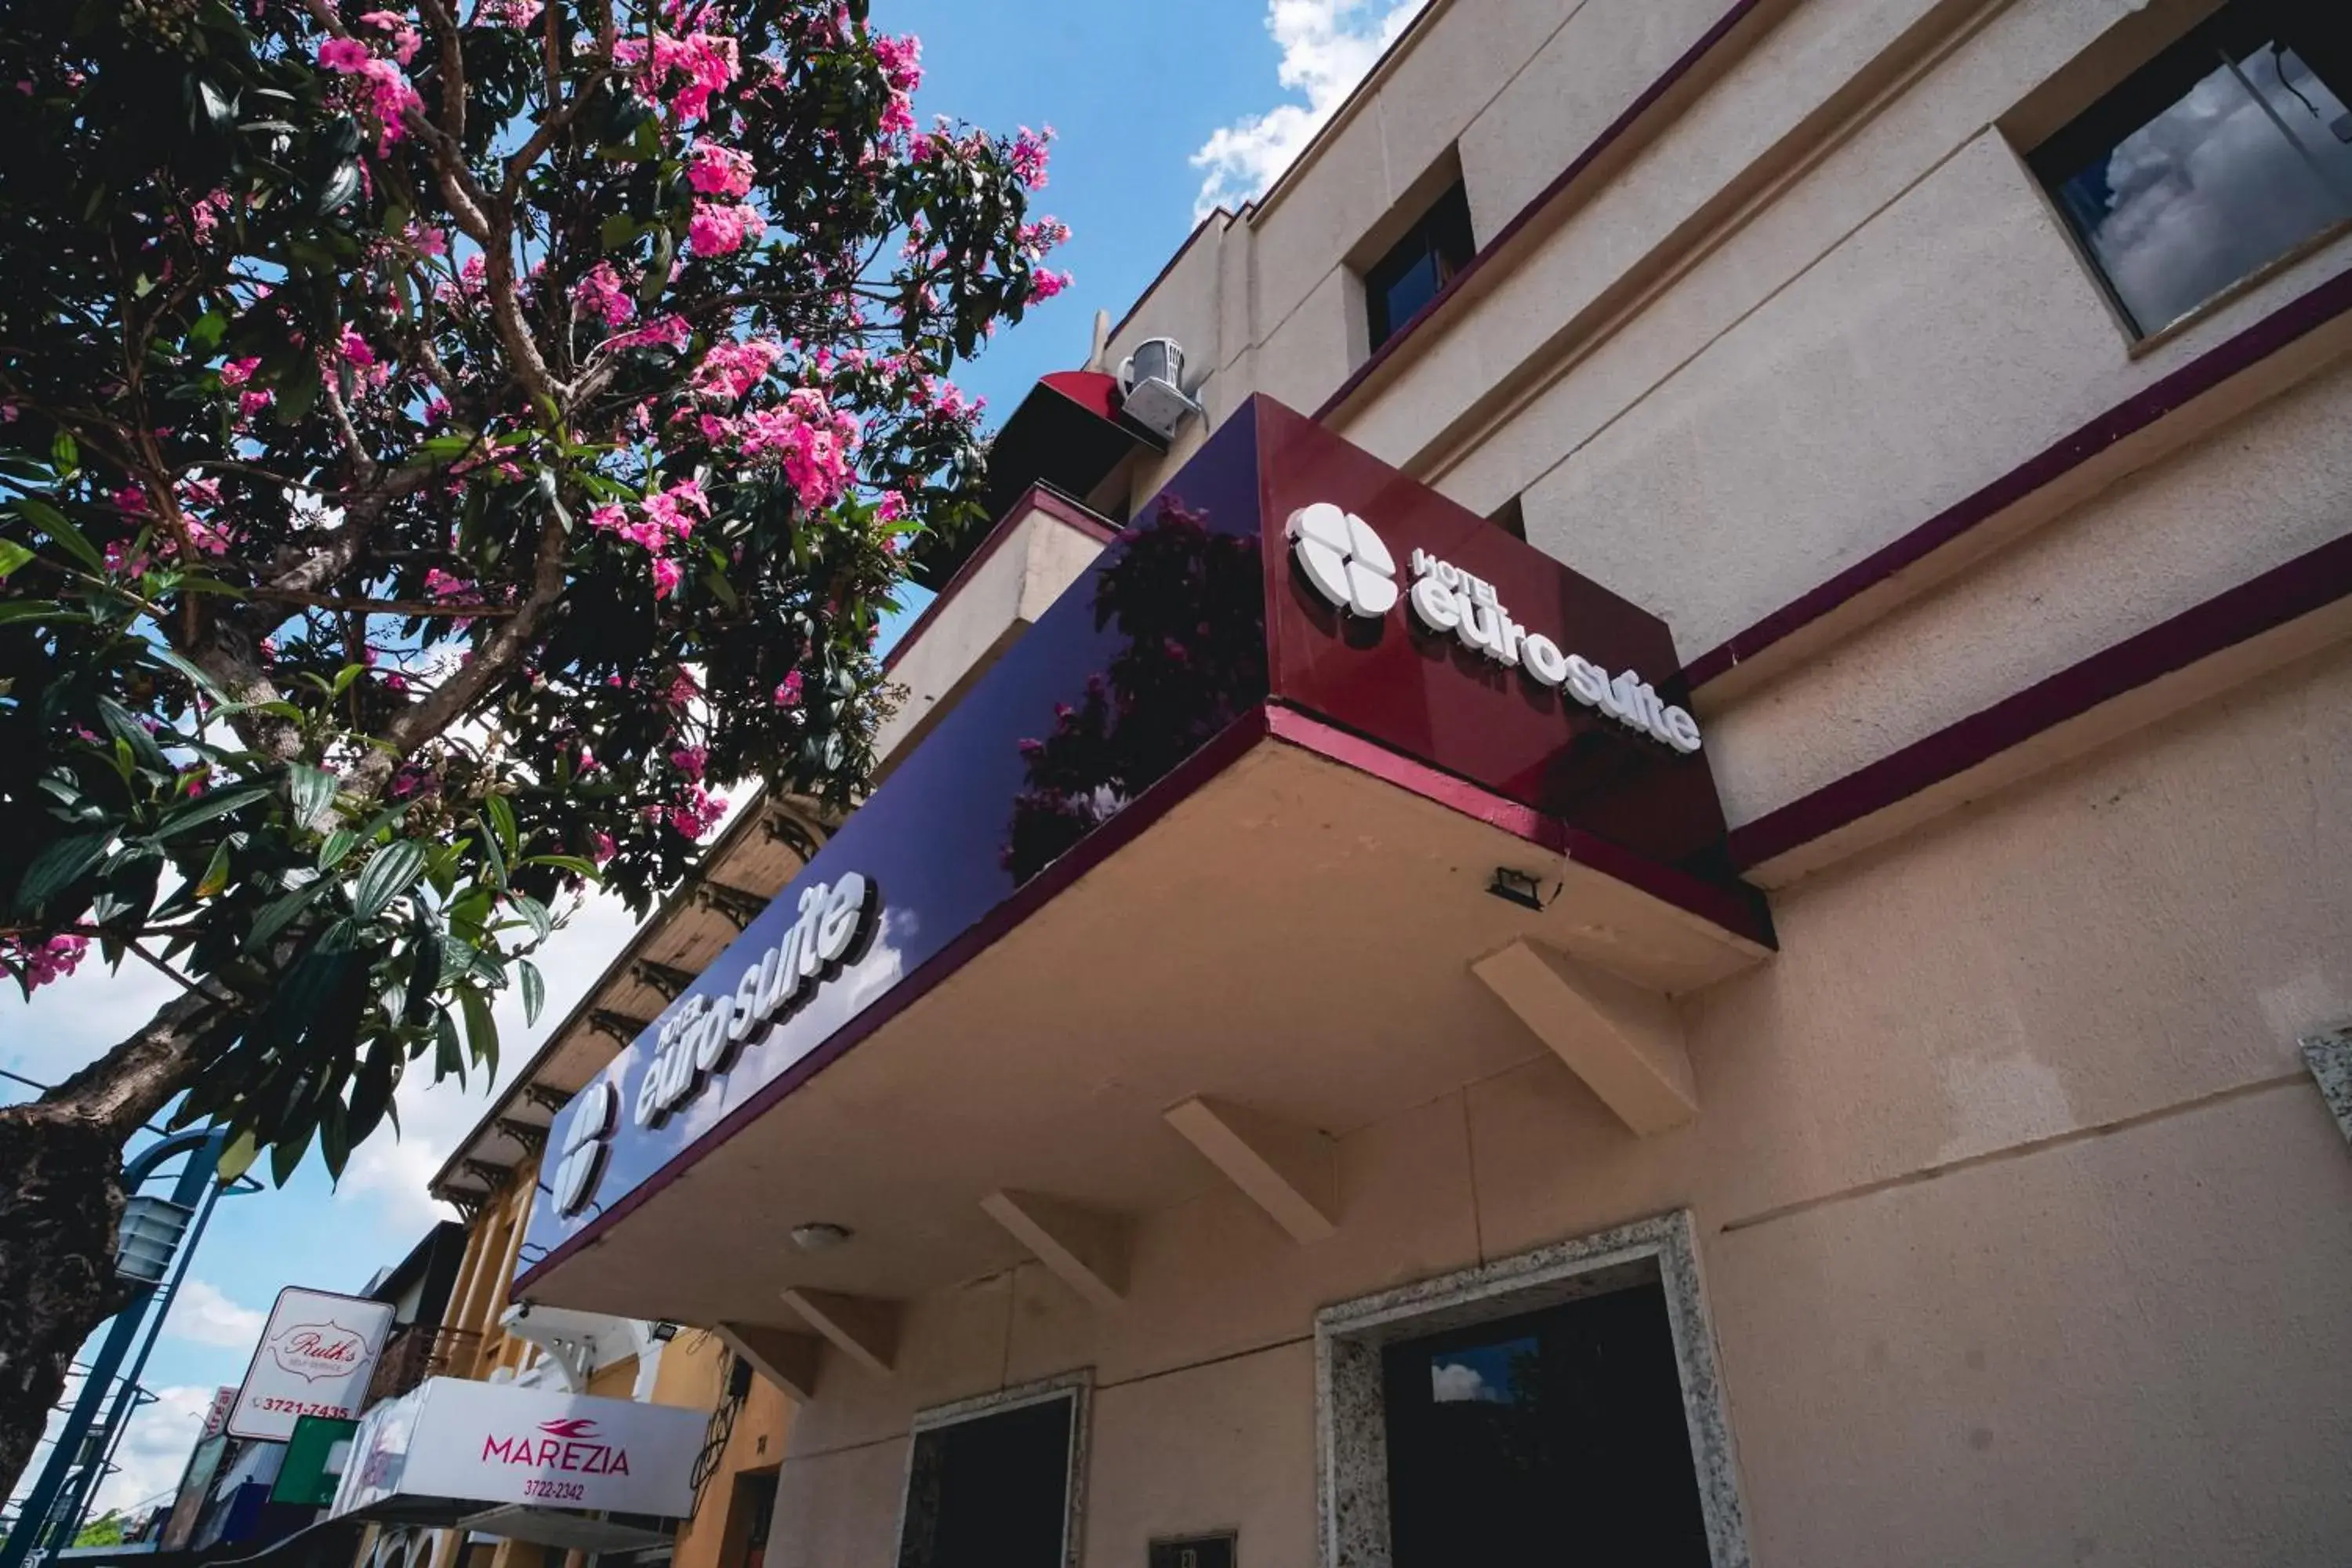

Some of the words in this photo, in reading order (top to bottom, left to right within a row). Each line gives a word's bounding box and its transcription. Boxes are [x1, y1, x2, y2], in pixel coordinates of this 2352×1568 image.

[1412, 547, 1508, 614] HOTEL
[1411, 577, 1701, 753] eurosuite
[634, 871, 866, 1125] eurosuite
[263, 1398, 350, 1418] 3721-7435
[482, 1433, 630, 1475] MAREZIA
[524, 1480, 585, 1501] 3722-2342
